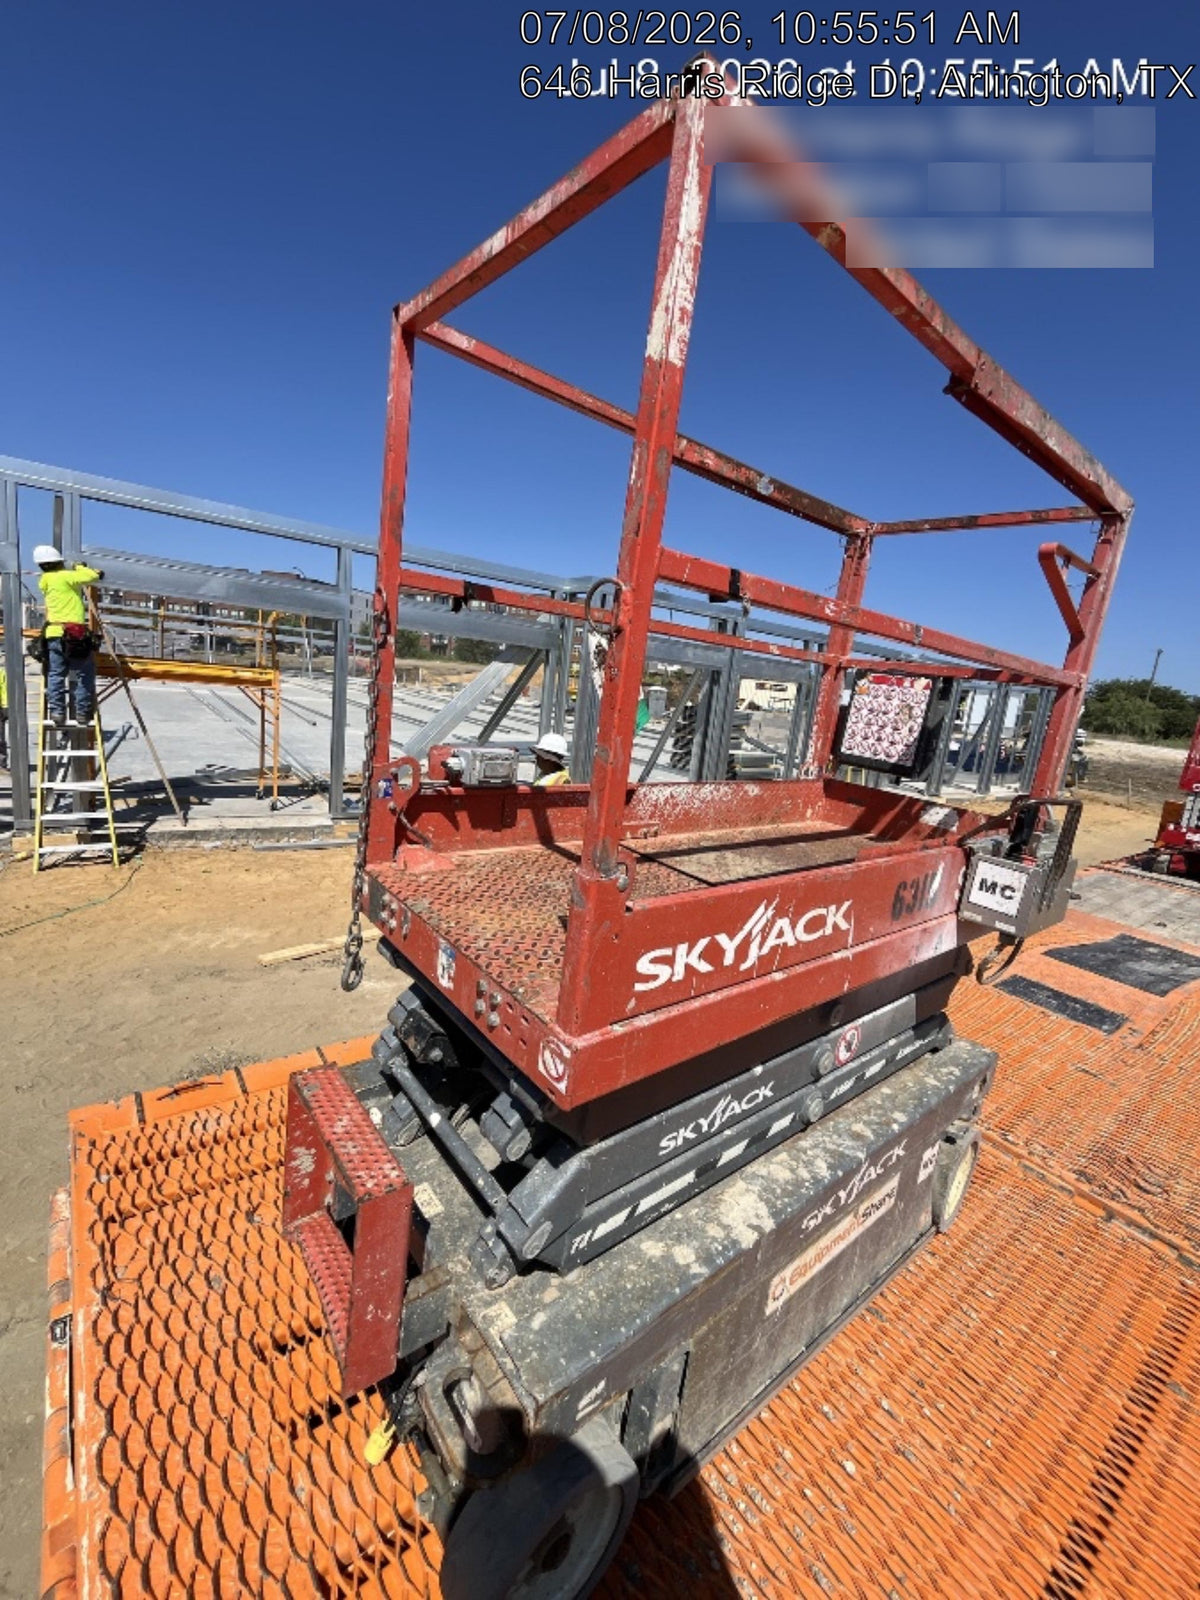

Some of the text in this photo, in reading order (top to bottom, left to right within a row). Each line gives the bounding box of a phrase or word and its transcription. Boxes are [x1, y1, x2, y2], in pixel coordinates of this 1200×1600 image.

[978, 877, 1016, 900] MC
[634, 896, 853, 992] SKYJACK
[658, 1080, 775, 1156] SKYJACK
[800, 1138, 908, 1239] SKYJACK
